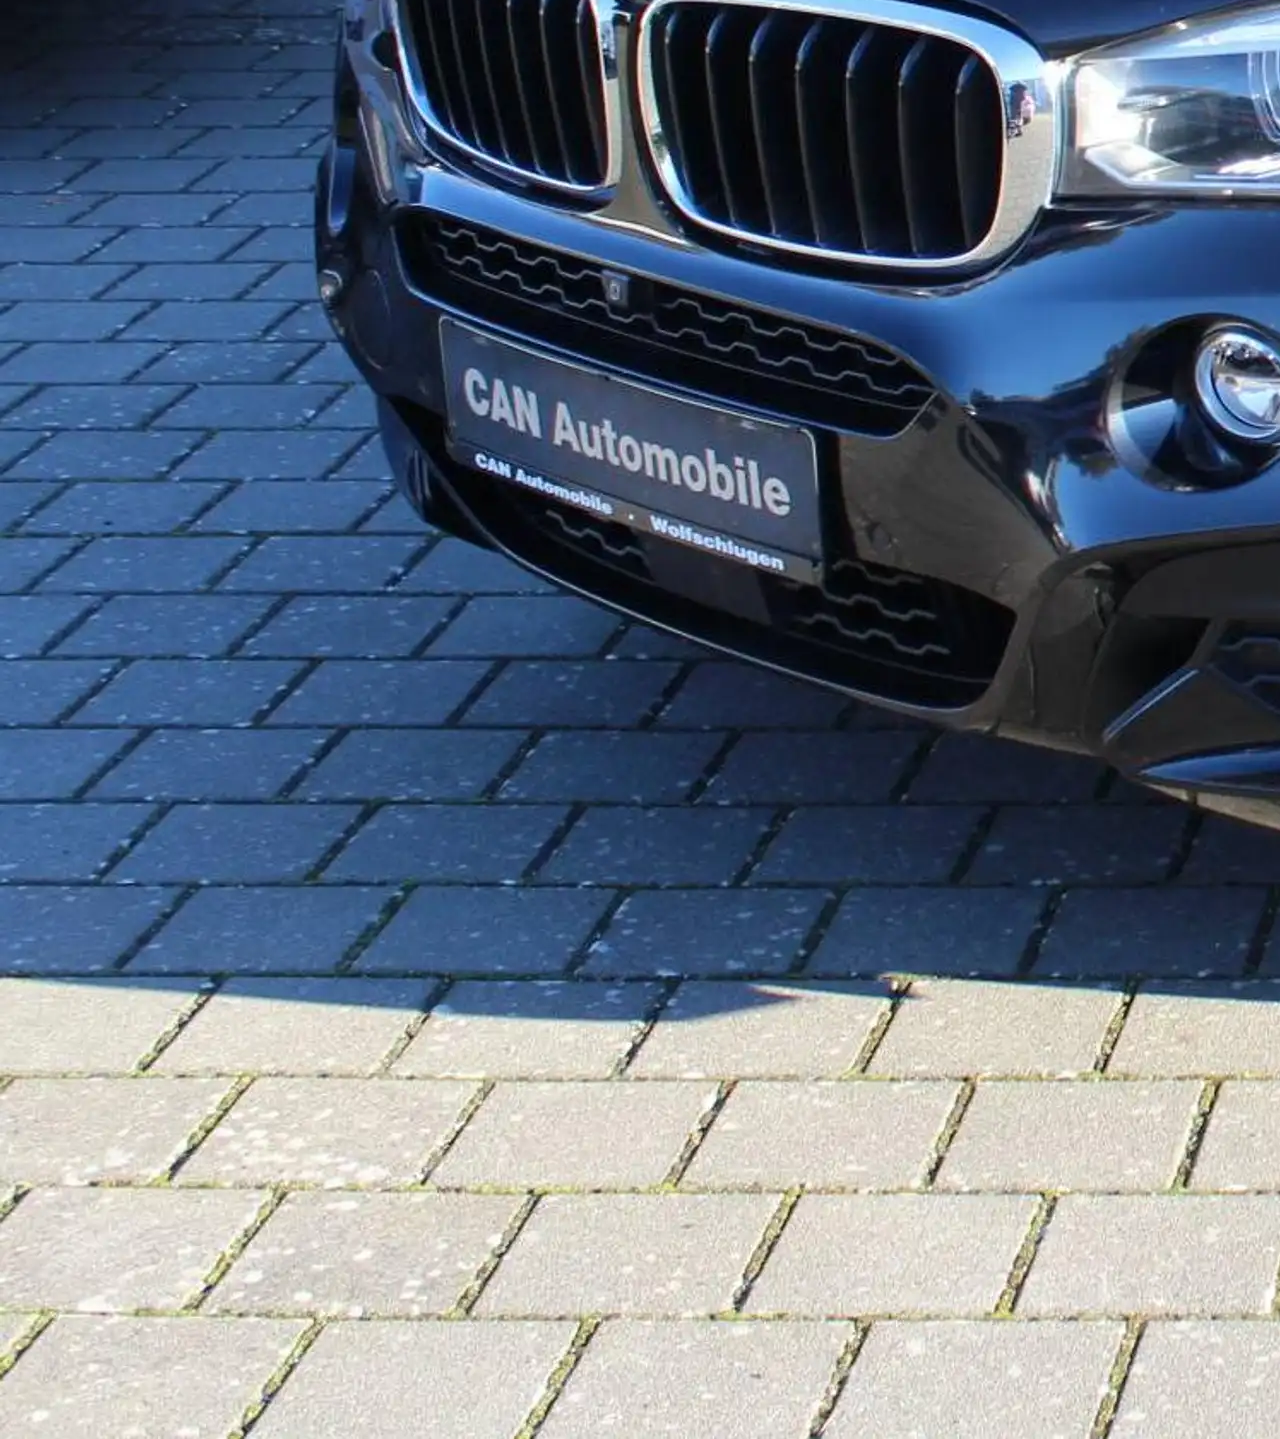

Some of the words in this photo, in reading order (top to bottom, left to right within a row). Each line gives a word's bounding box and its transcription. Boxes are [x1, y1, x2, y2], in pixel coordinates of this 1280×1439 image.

[463, 368, 542, 439] CAN
[552, 401, 792, 517] Automobile
[474, 452, 511, 479] CAN
[515, 467, 614, 516] Automobile
